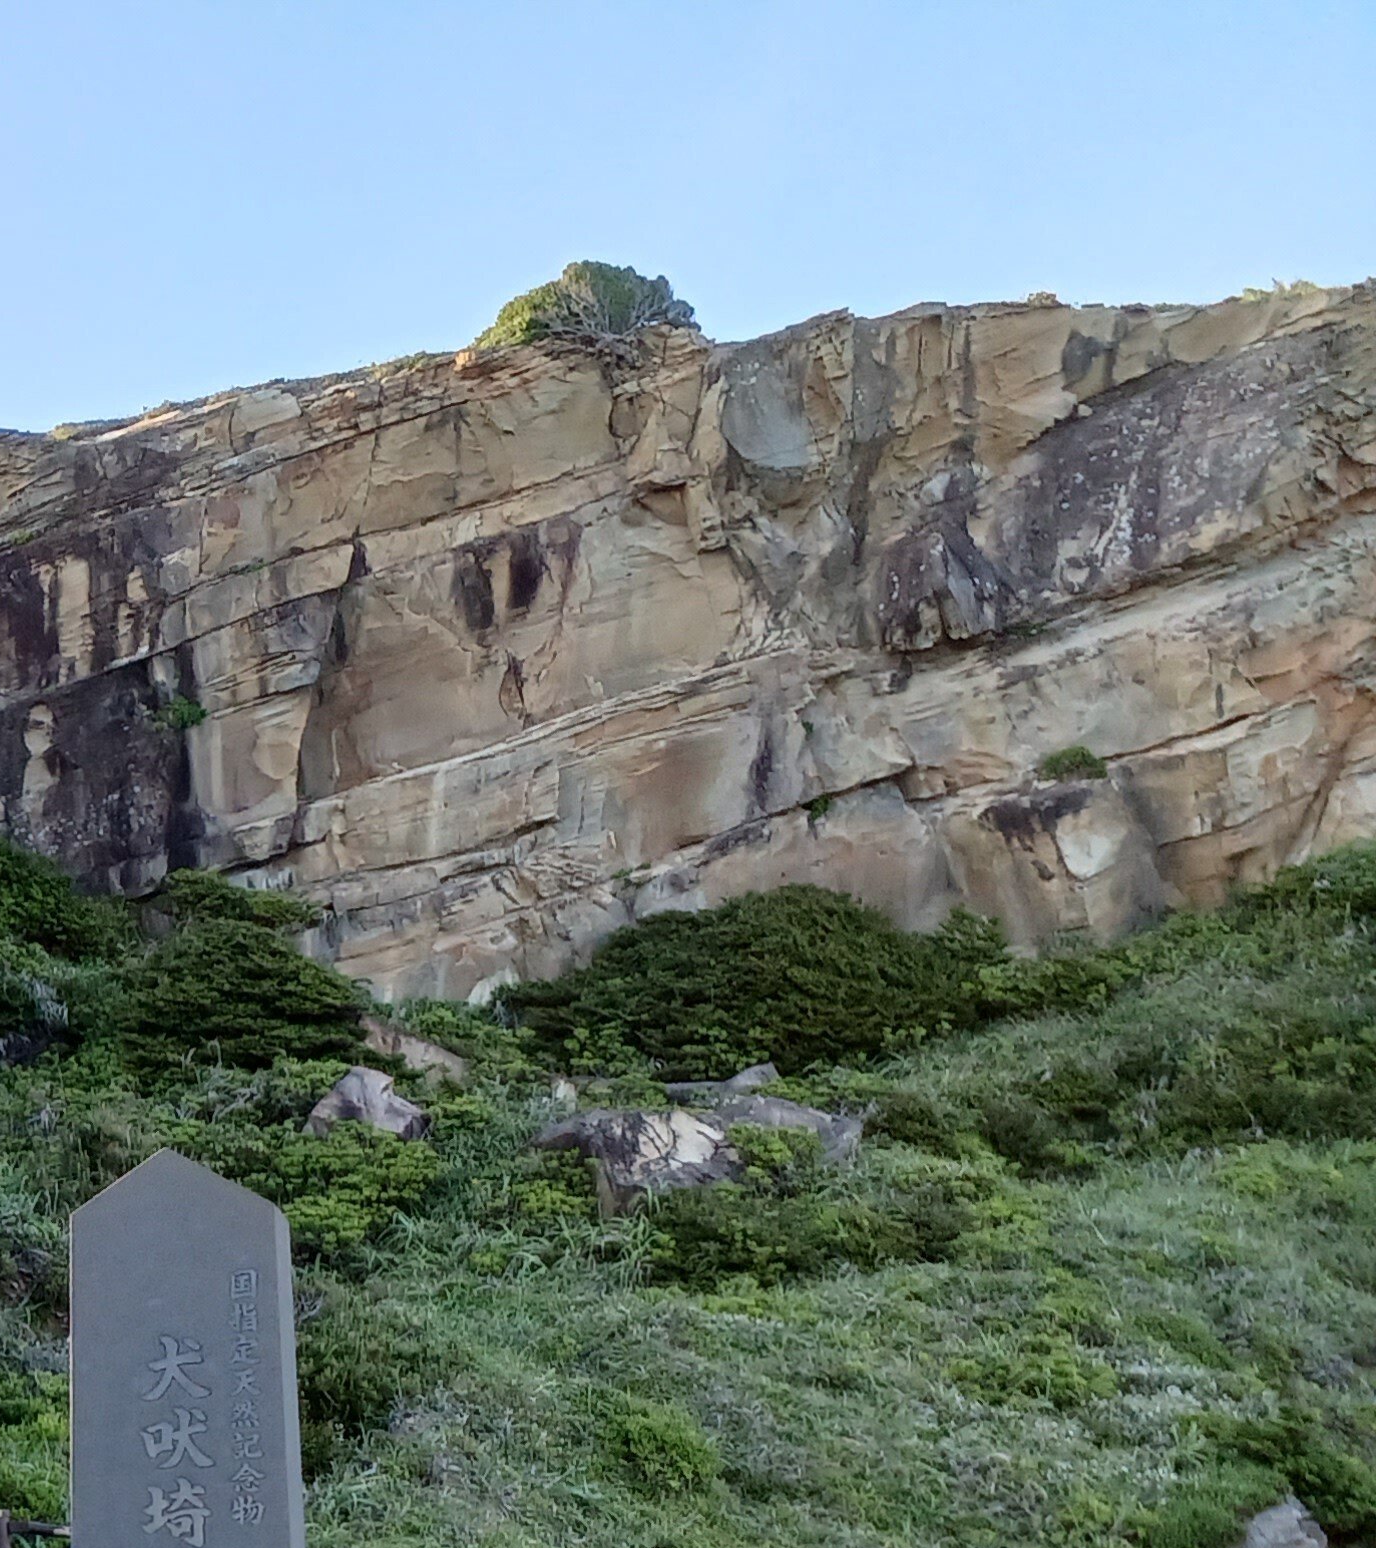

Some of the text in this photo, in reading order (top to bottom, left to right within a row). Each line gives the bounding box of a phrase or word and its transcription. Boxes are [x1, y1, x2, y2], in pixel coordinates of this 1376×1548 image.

[229, 1268, 265, 1525] 国指定天然記念物
